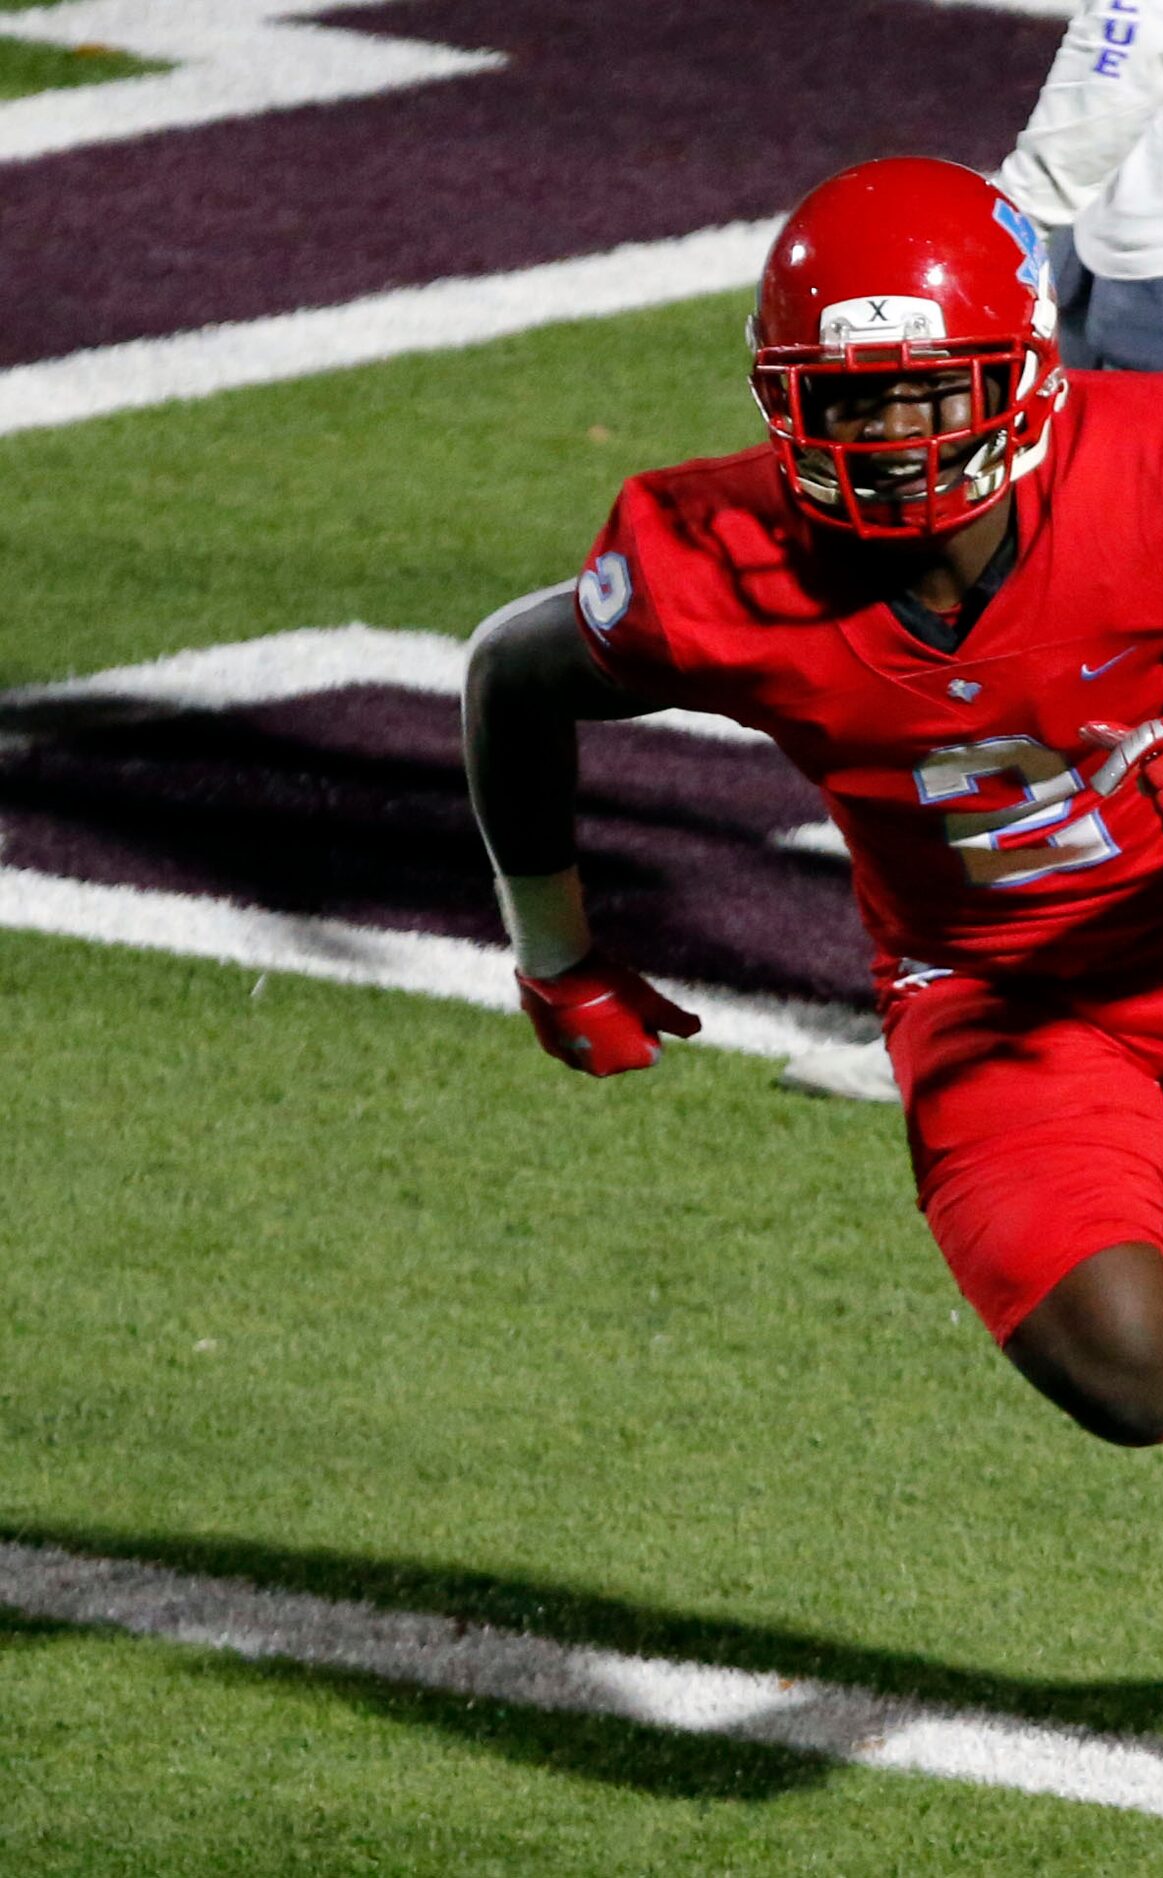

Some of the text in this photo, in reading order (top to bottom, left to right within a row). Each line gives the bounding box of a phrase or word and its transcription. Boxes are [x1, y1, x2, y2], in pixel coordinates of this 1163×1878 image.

[867, 299, 889, 322] X
[579, 551, 632, 648] 2
[913, 734, 1123, 888] 2
